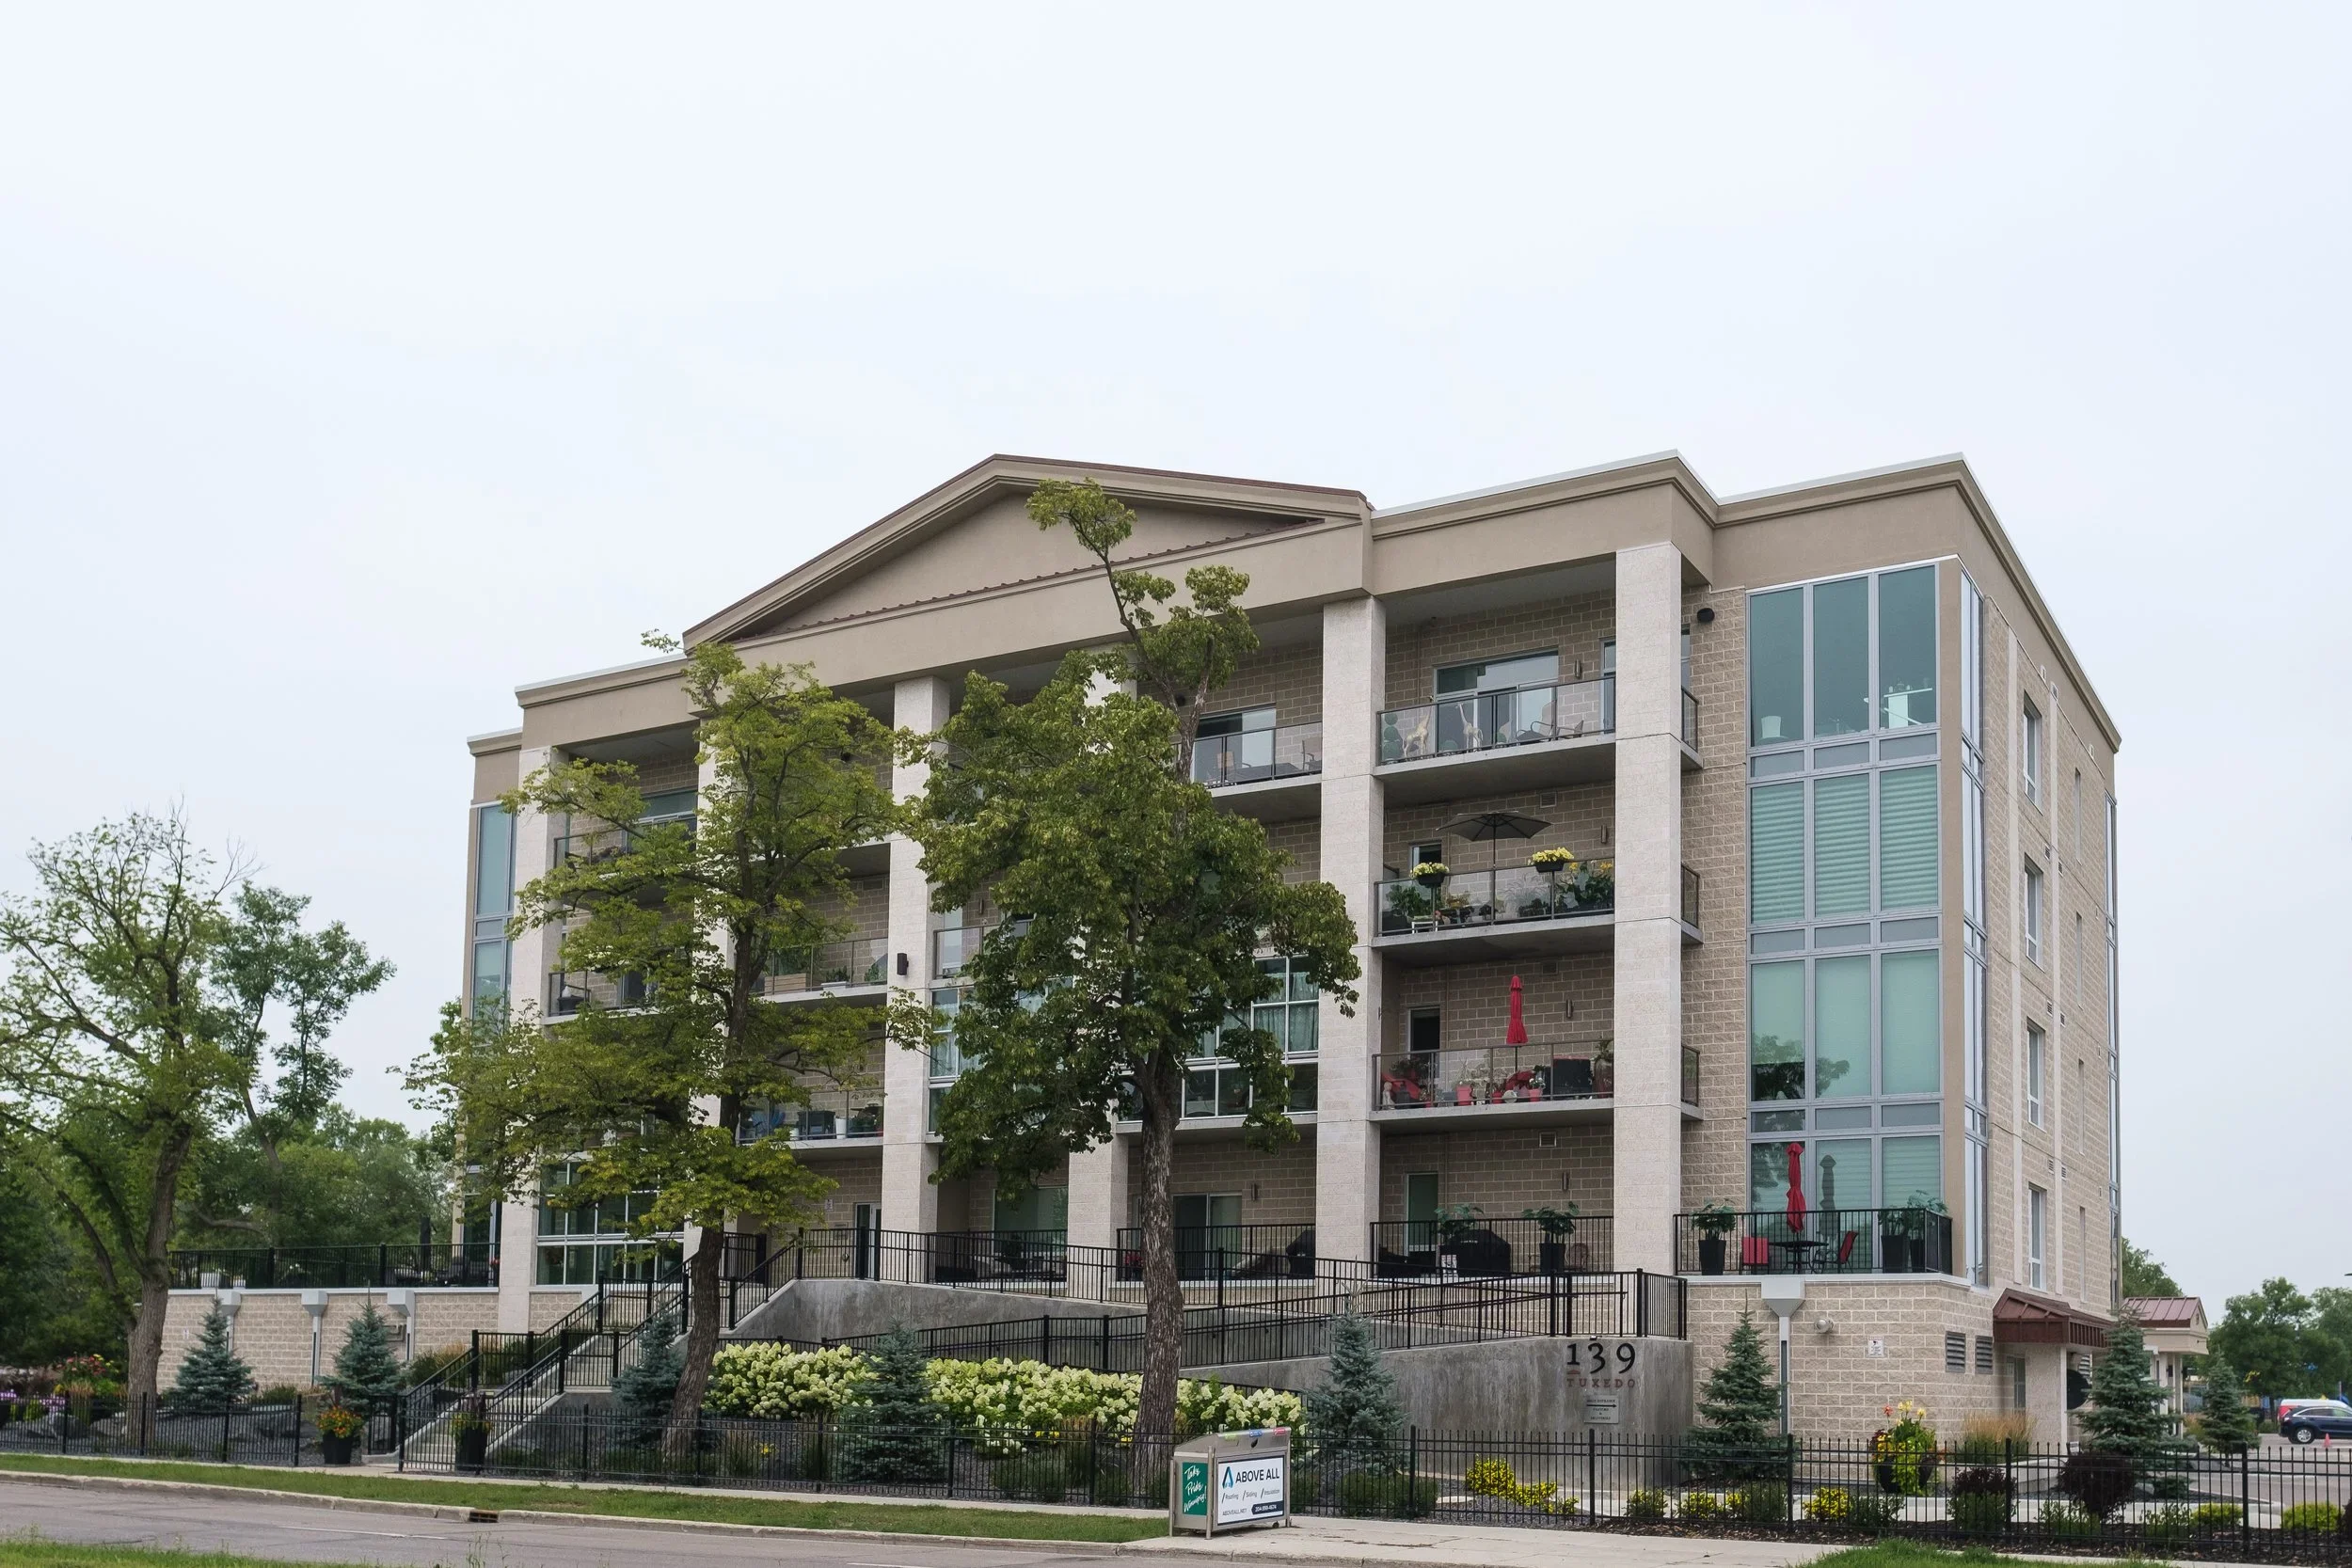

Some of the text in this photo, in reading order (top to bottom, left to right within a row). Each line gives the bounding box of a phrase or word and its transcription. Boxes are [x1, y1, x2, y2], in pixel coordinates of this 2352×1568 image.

[1566, 1342, 1636, 1374] 139
[1566, 1379, 1636, 1388] TUXEDO
[1184, 1465, 1200, 1481] Take
[1235, 1467, 1280, 1483] ABOVE ALL
[1184, 1481, 1203, 1496] Pride
